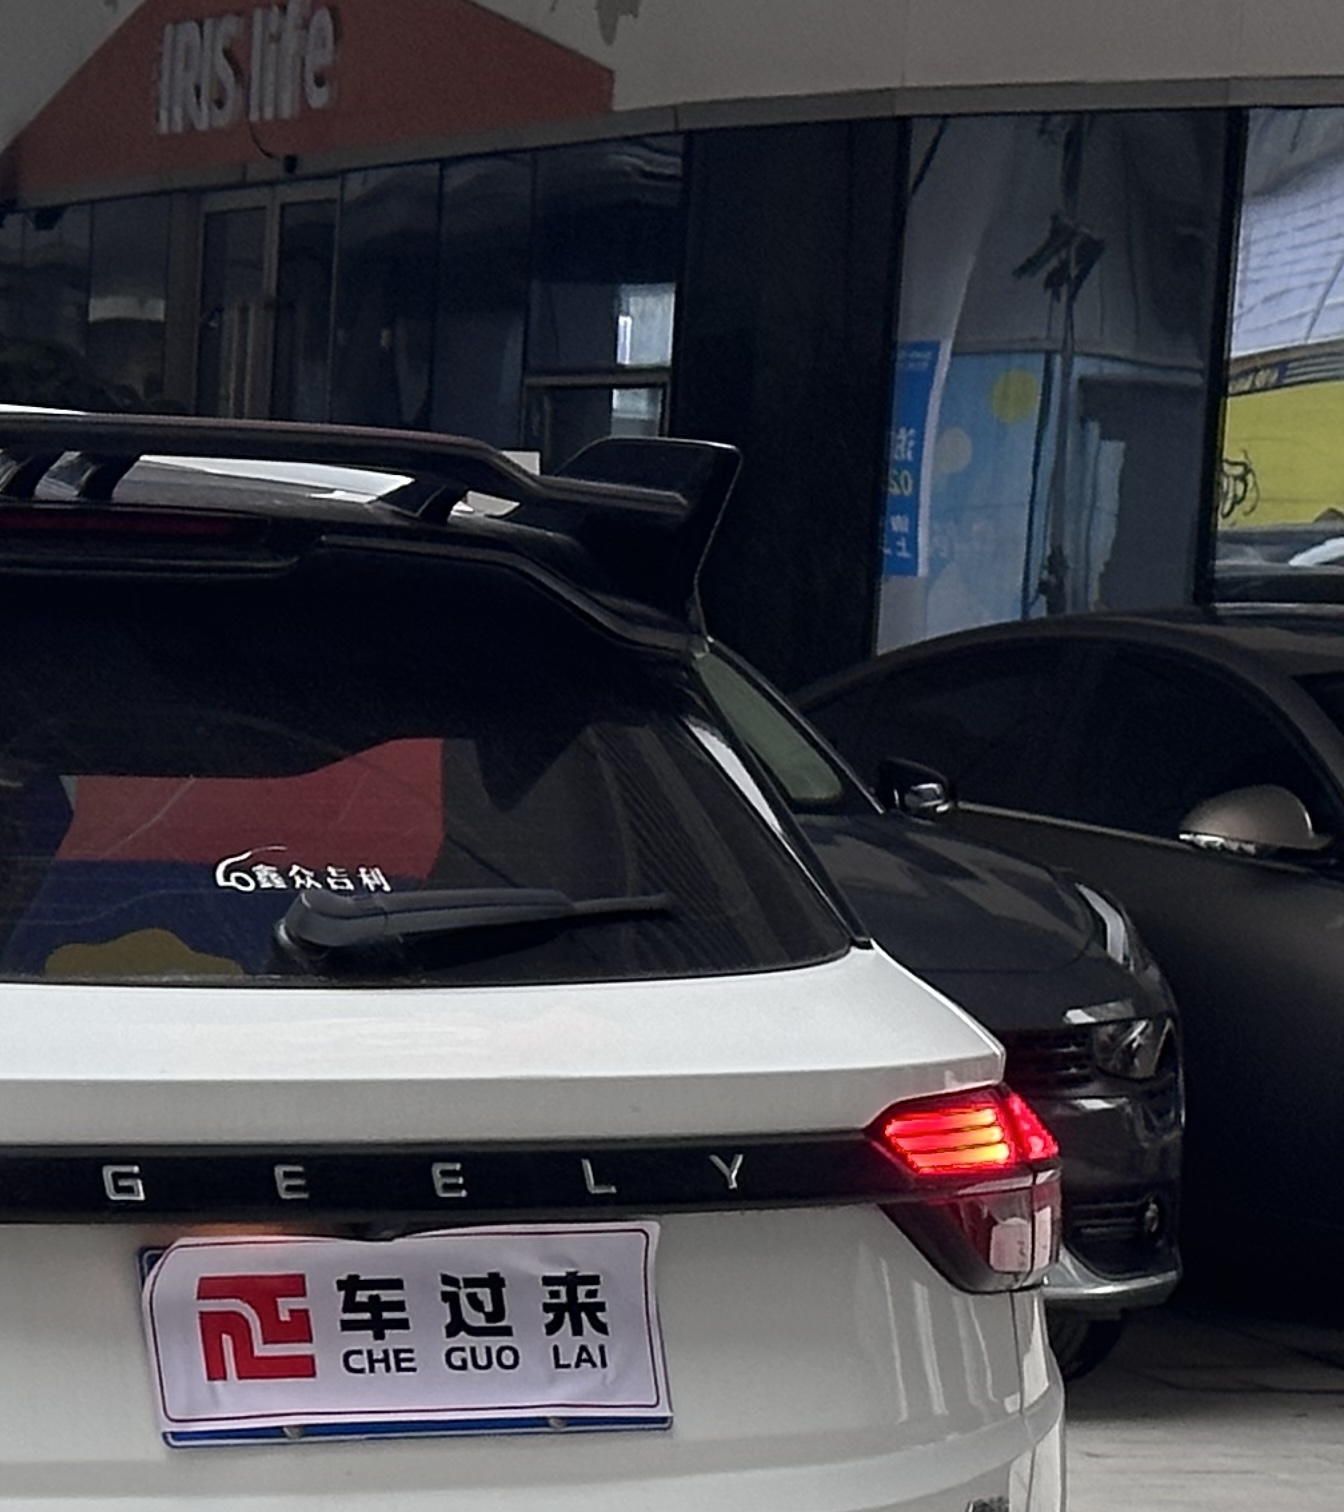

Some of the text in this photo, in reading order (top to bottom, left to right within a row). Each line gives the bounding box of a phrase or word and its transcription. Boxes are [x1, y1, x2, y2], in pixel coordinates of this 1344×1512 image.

[158, 0, 337, 134] IRIS life
[101, 1152, 744, 1202] GEELY
[336, 1270, 609, 1341] 车过来
[342, 1342, 609, 1375] CHE GUO LAI
